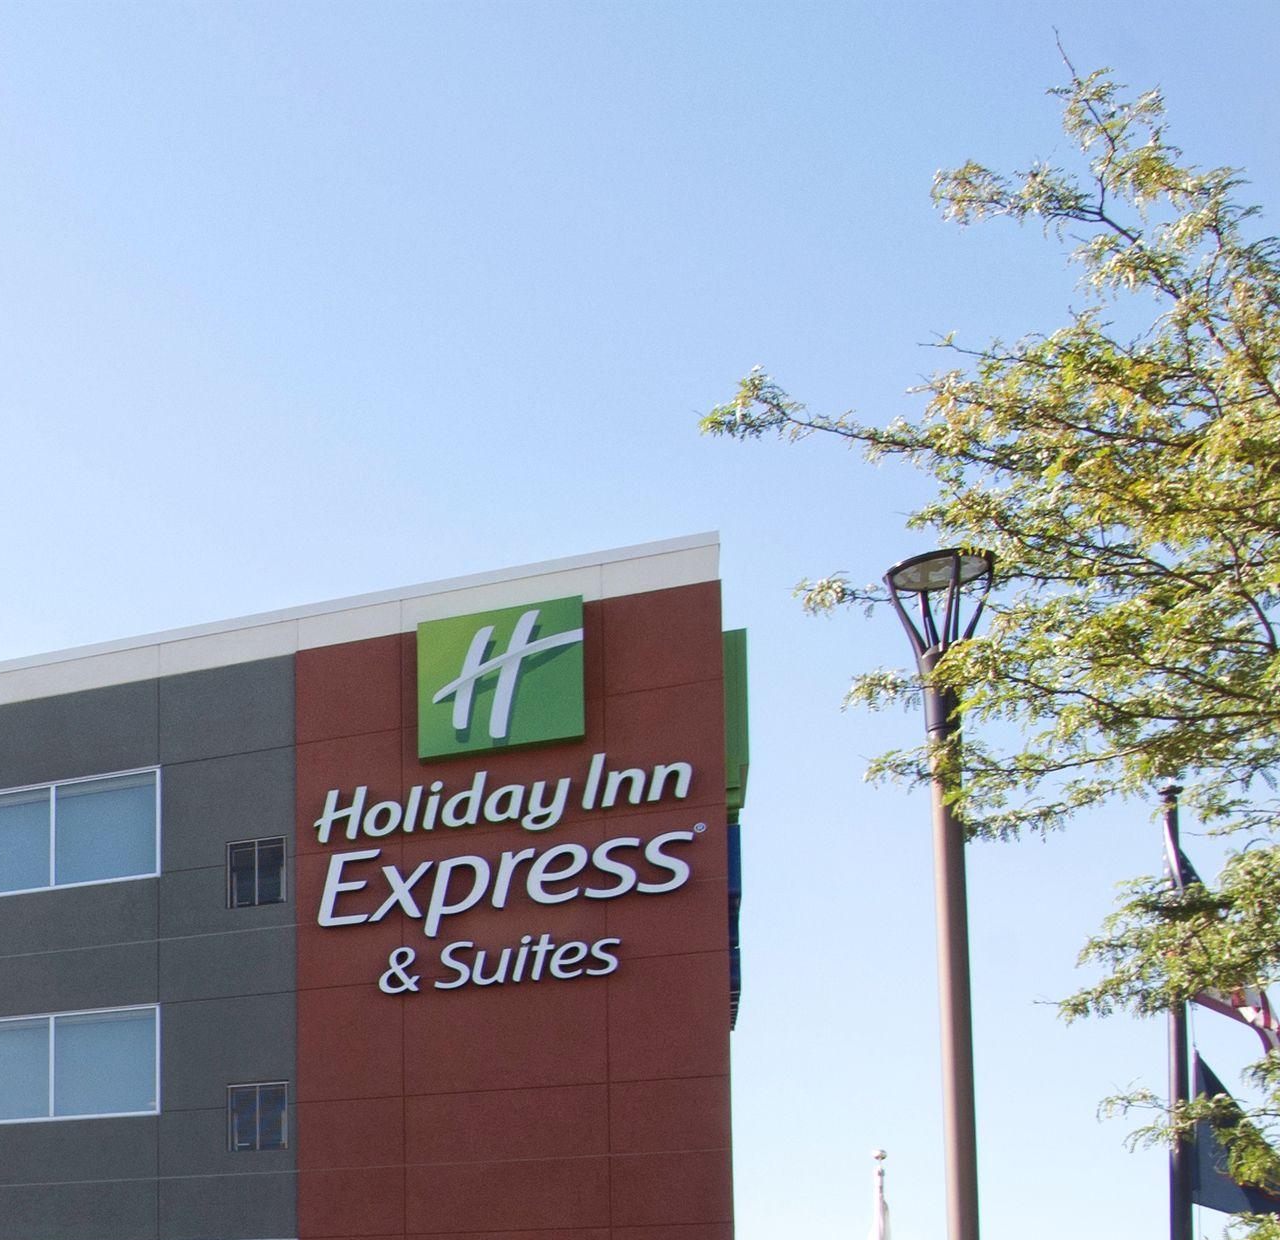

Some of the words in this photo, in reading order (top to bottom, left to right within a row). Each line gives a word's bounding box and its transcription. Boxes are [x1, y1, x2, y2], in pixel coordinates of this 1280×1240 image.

[314, 771, 571, 843] Holiday
[582, 753, 693, 809] Inn
[378, 947, 420, 993] &
[433, 934, 621, 990] Suites
